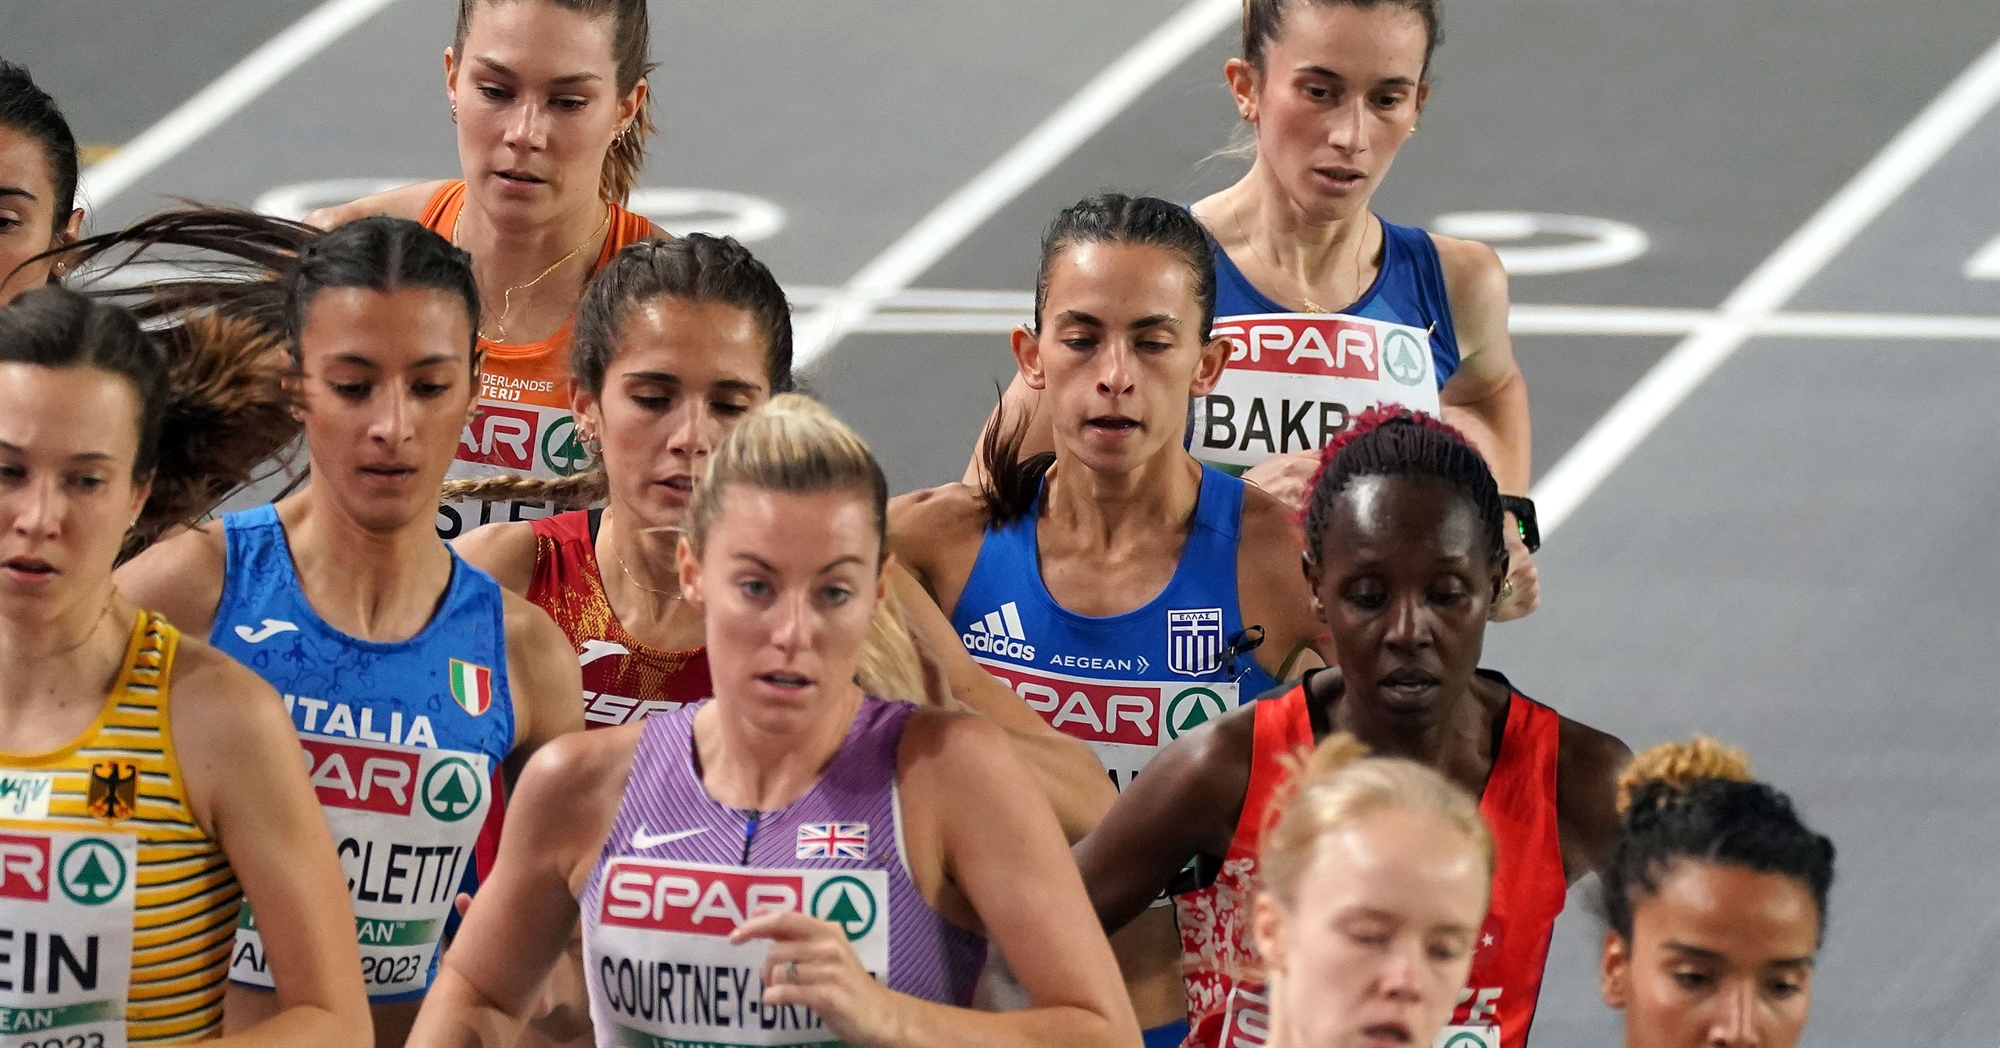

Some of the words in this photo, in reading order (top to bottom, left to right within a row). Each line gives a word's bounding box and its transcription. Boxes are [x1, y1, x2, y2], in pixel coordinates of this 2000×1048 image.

[481, 372, 554, 392] DERLANDSE
[1202, 394, 1430, 454] BAKR
[435, 499, 565, 540] STE
[962, 632, 1036, 661] adidas
[1049, 654, 1132, 671] AEGEAN
[993, 675, 1154, 737] PAR
[304, 752, 411, 806] AR
[362, 955, 422, 985] 2023
